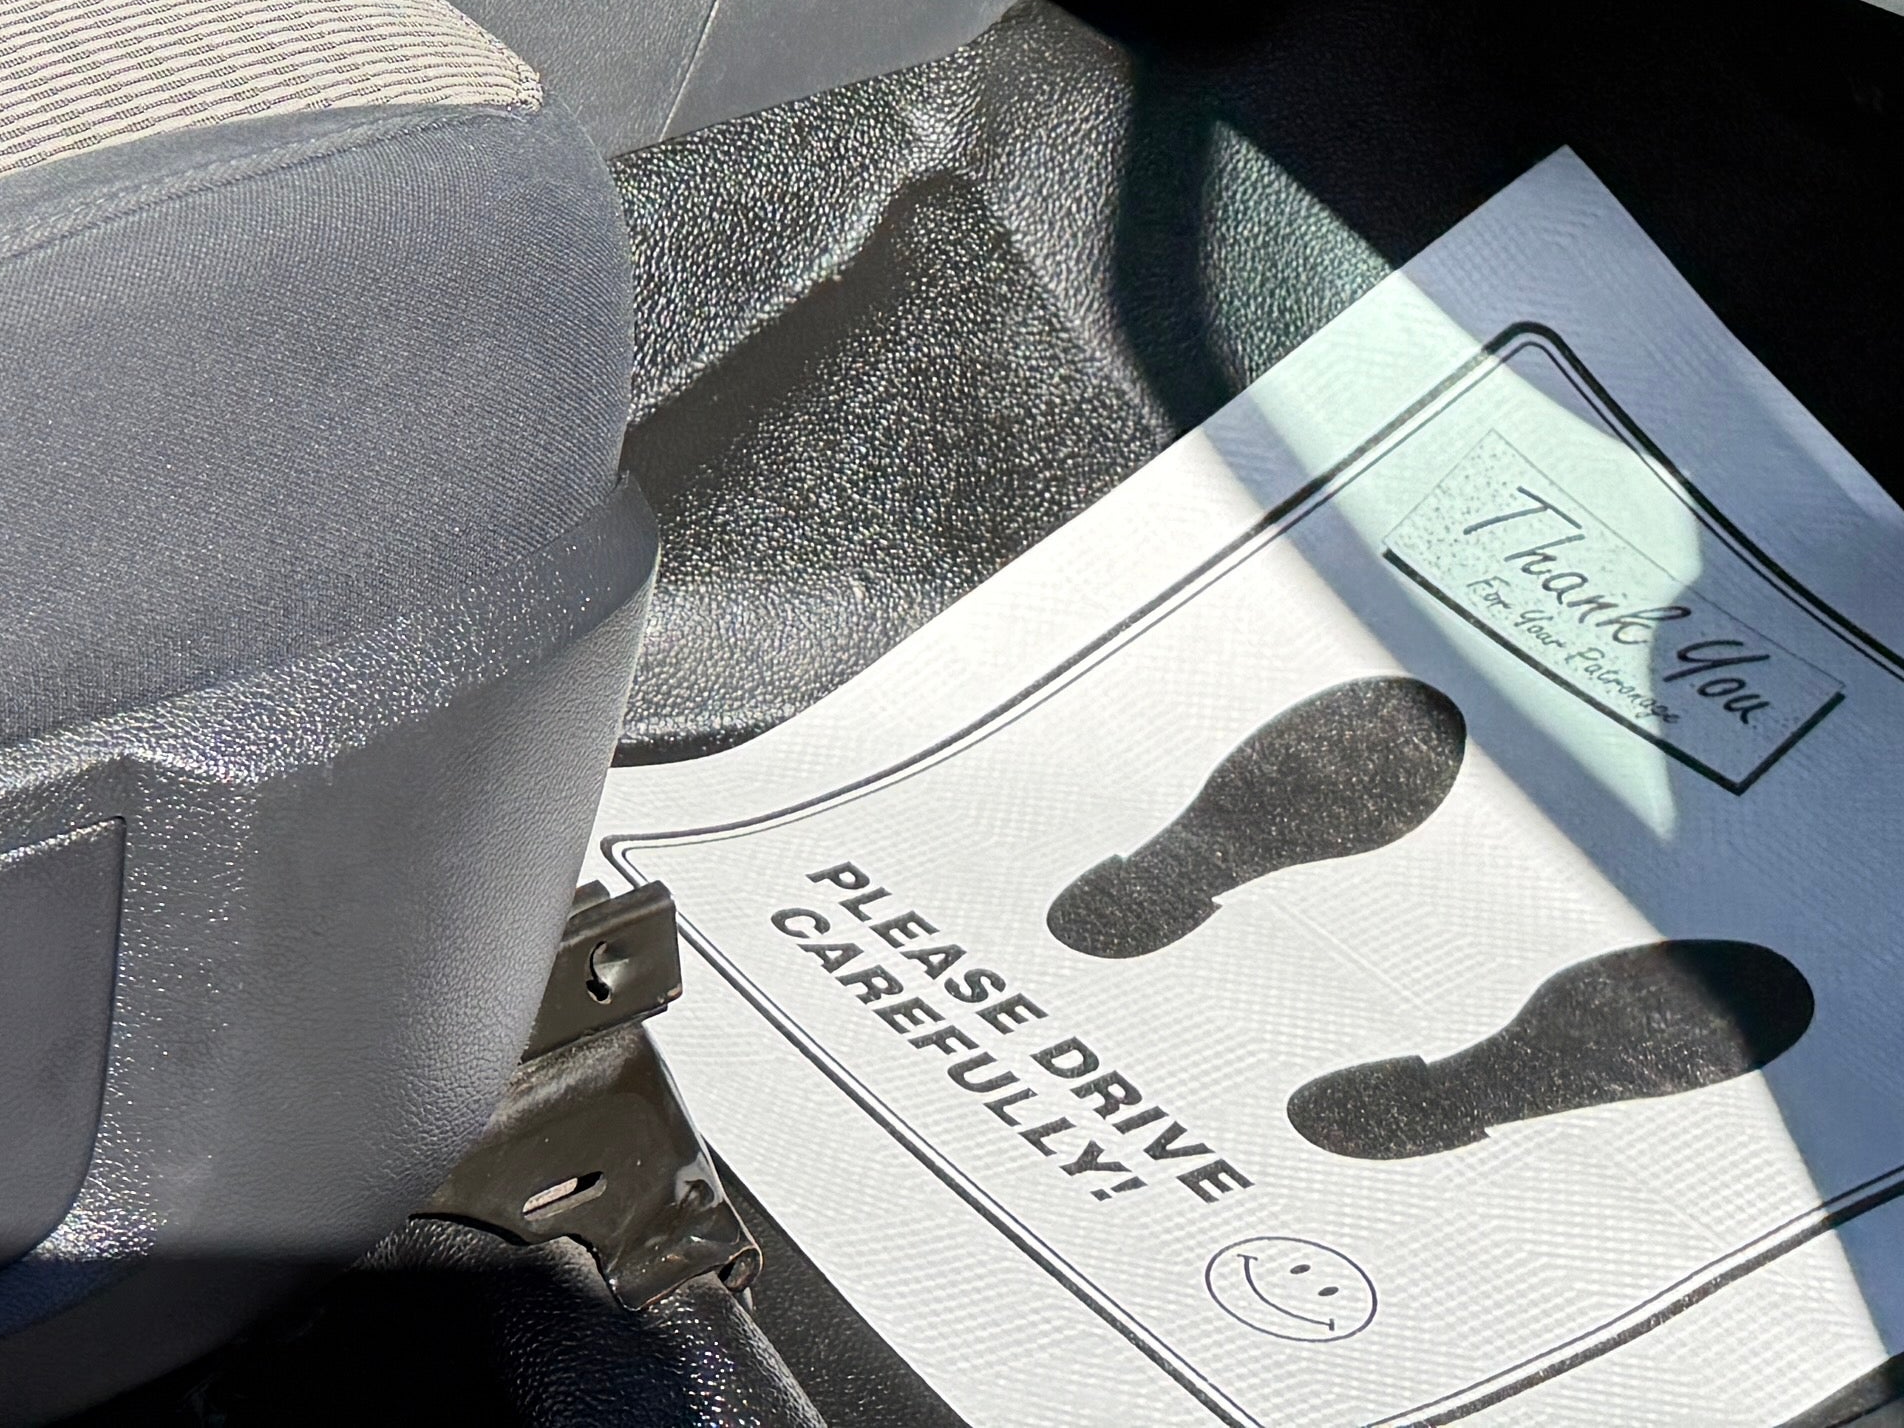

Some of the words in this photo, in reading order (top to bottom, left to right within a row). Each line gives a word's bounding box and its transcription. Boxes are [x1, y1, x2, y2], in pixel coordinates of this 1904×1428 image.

[1463, 485, 1692, 646] Thank
[1663, 639, 1772, 725] You
[1466, 575, 1512, 614] For
[1516, 608, 1567, 650] Your
[1564, 646, 1681, 726] Patronage
[770, 907, 1148, 1202] CAREFULLY!
[805, 860, 1050, 1035] PLEASE
[1030, 1036, 1256, 1204] DRIVE
